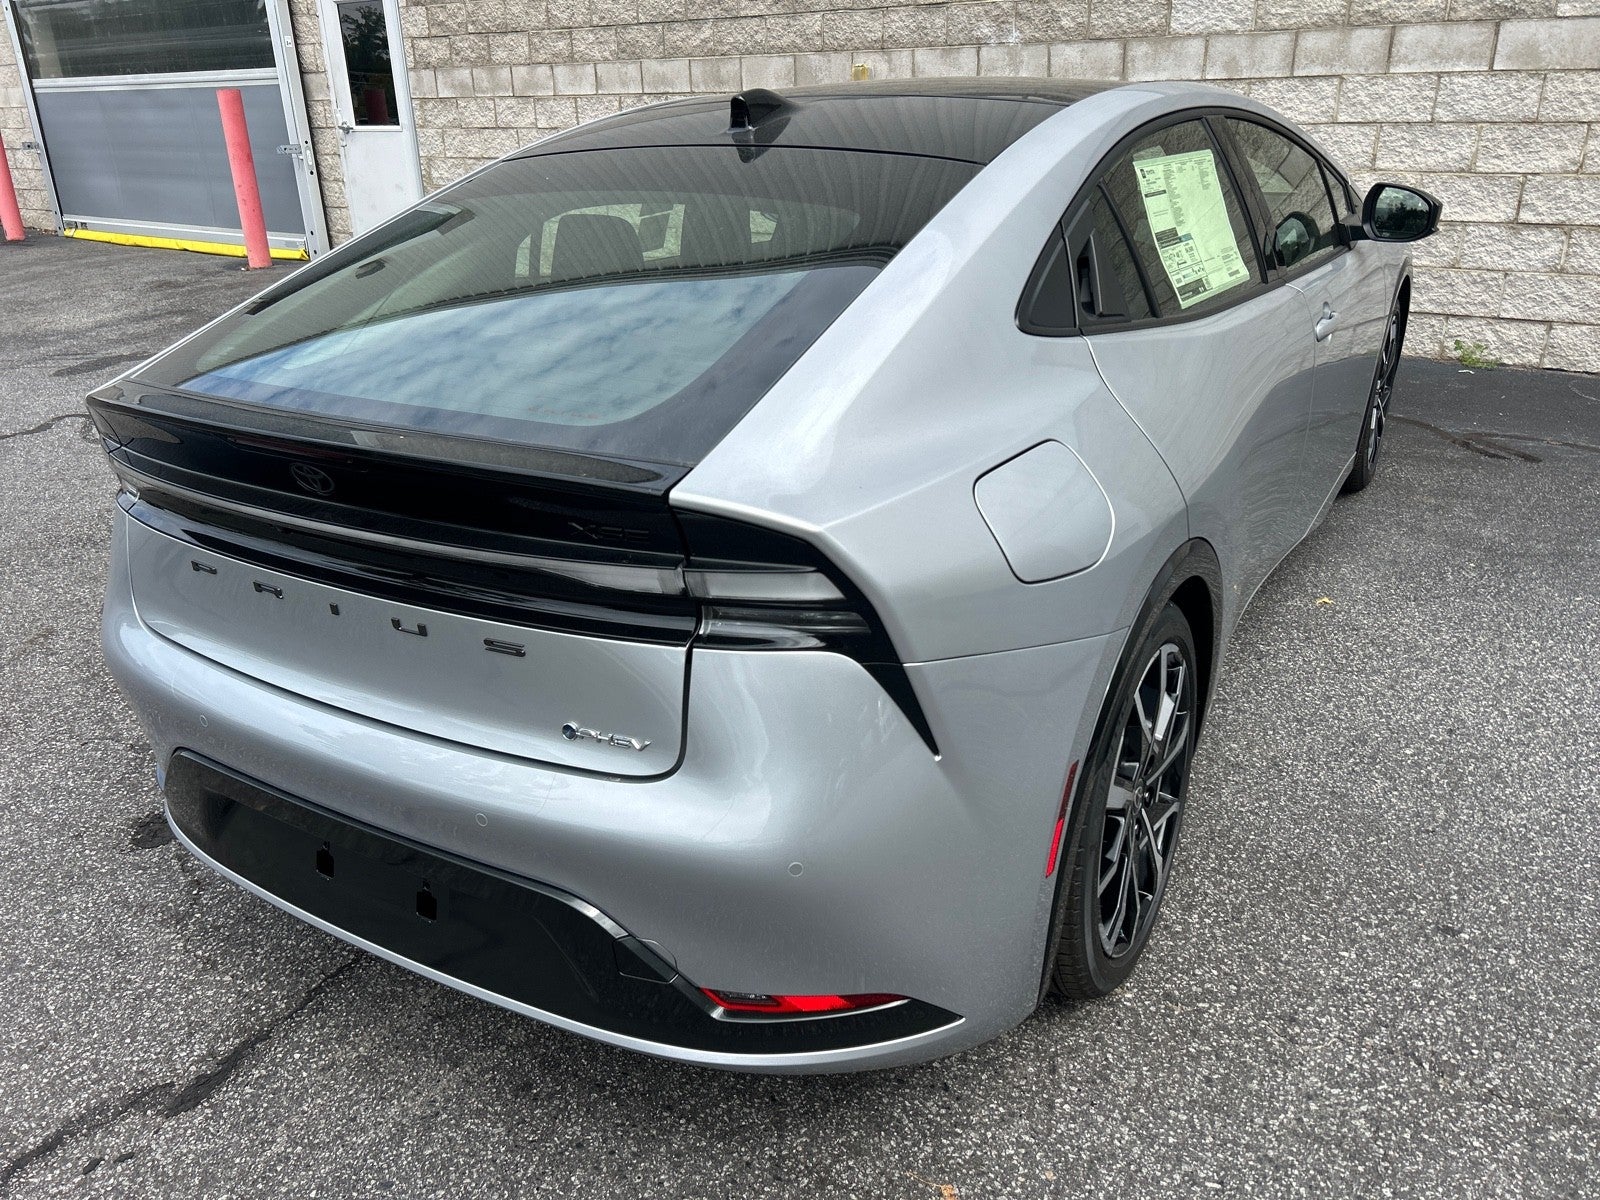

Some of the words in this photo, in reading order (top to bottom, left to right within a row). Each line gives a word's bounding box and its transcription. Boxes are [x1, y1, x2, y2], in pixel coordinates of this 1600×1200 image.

[567, 522, 650, 543] XSE
[191, 561, 526, 656] PRIUS
[576, 727, 651, 751] PHEV
